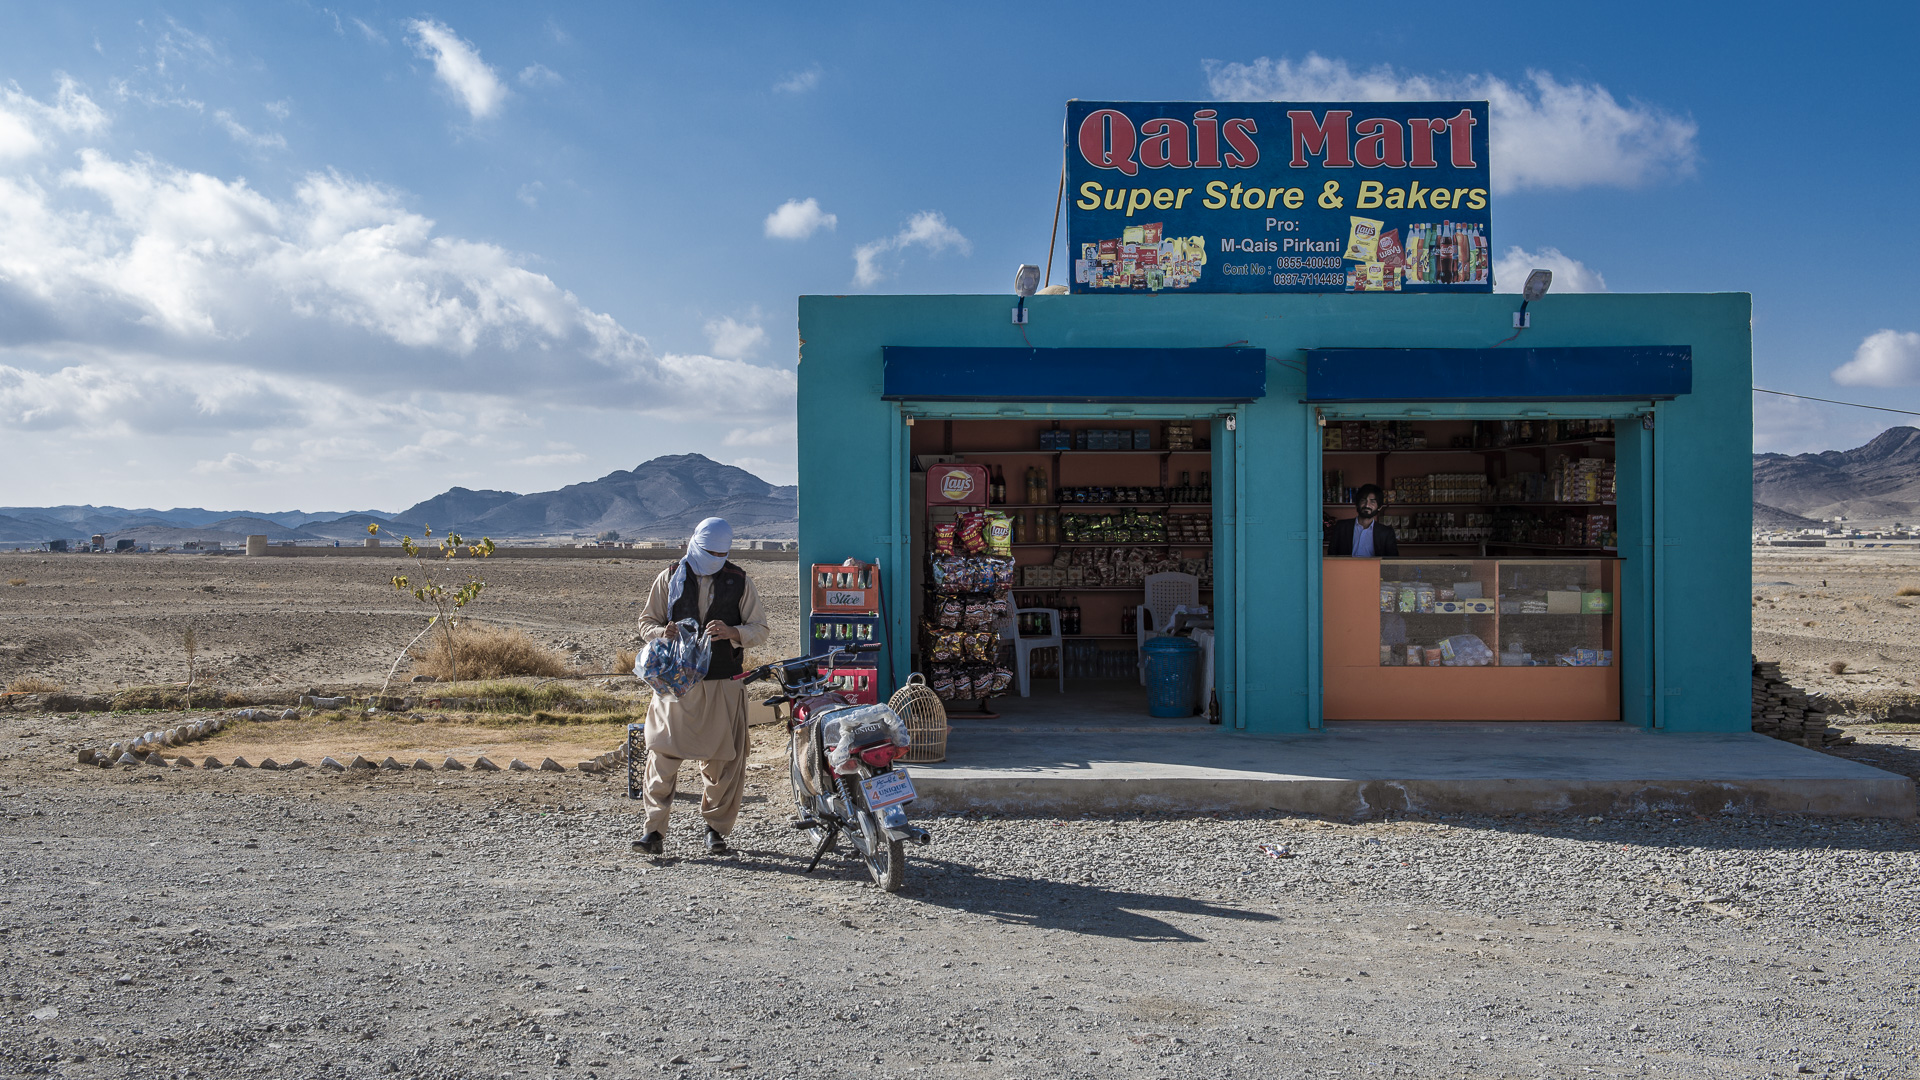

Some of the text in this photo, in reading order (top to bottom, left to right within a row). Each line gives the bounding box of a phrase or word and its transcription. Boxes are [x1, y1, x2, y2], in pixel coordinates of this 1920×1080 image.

[1078, 109, 1478, 177] Qais Mart
[1076, 181, 1488, 217] Super Store & Bakers
[1266, 217, 1300, 232] Pro:
[1221, 238, 1340, 253] M-Qais Pirkani
[1222, 263, 1248, 276] Cont
[1250, 263, 1266, 275] No
[1276, 256, 1342, 270] 0855-400409
[1273, 272, 1344, 286] 0337-7114485
[829, 592, 861, 605] Slice
[878, 783, 907, 796] UNIQUE
